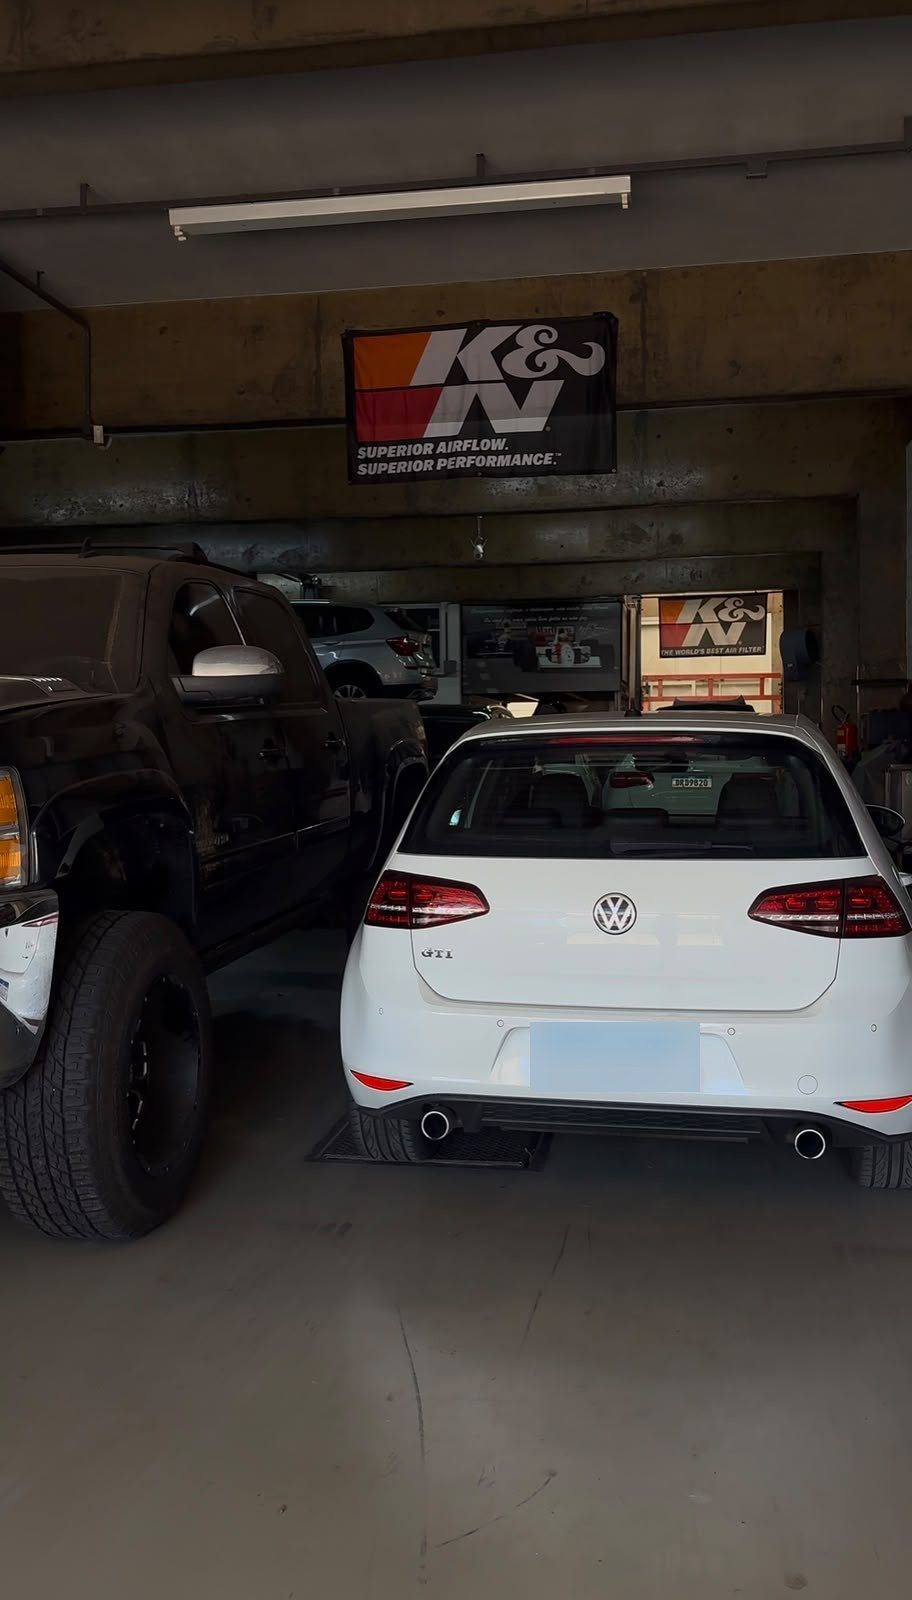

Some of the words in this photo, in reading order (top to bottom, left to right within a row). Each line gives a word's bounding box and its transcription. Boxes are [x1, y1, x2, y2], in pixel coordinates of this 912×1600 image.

[357, 443, 434, 459] SUPERIOR
[436, 438, 509, 454] AIRFLOW.
[357, 459, 435, 475] SUPERIOR
[675, 648, 705, 656] WORLD'S
[706, 647, 723, 655] BEST
[421, 948, 453, 959] GTI
